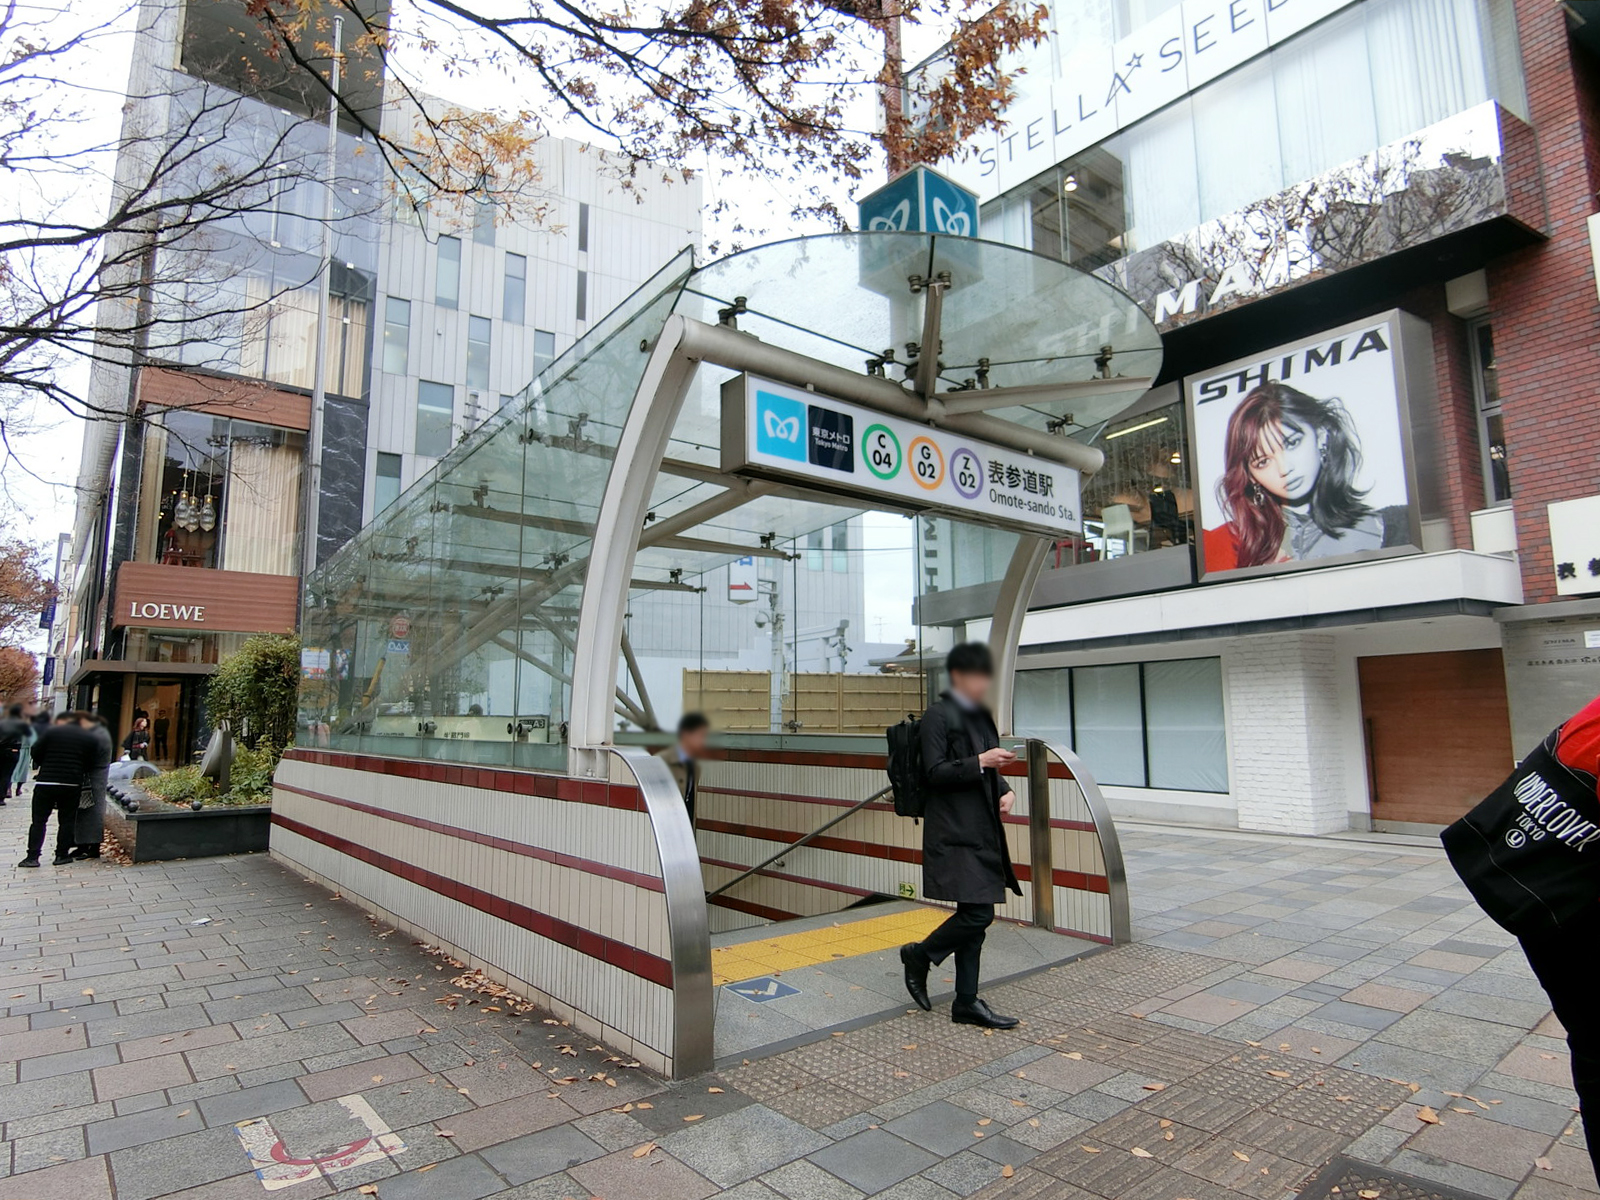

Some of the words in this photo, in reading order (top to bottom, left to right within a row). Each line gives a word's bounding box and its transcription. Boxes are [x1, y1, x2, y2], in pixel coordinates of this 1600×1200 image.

[979, 52, 1145, 177] STELLA
[1196, 327, 1389, 405] SHIMA
[812, 426, 851, 445] 東京メトロ
[815, 437, 832, 449] Tokyo
[832, 441, 849, 452] Metro
[877, 433, 886, 449] C
[872, 449, 892, 468] 04
[921, 445, 931, 460] G
[917, 461, 936, 479] 02
[962, 456, 971, 470] Z
[959, 471, 975, 489] 02
[988, 460, 1054, 498] 表参道駅
[989, 488, 1056, 517] Omote-sando
[1058, 504, 1076, 521] Sta.
[130, 602, 205, 622] LOEWE
[1513, 771, 1600, 852] UNDERCOVER
[1515, 812, 1546, 841] TOKYO
